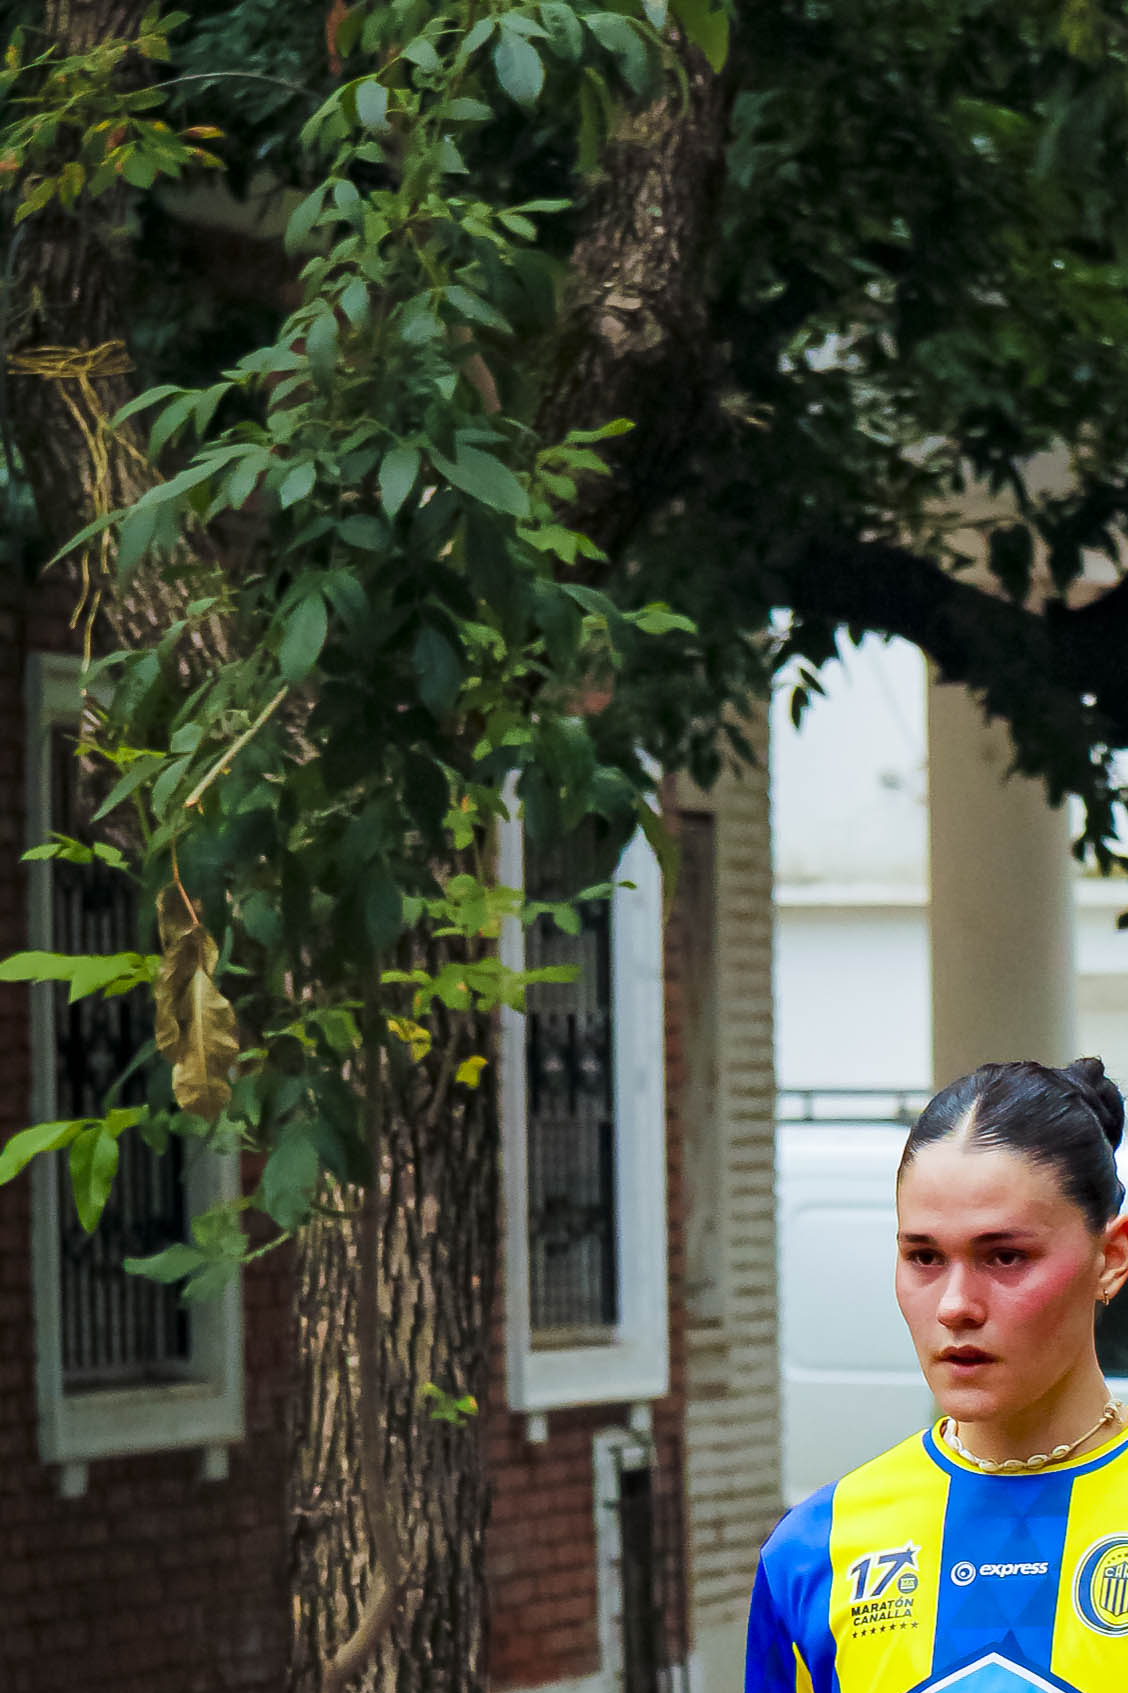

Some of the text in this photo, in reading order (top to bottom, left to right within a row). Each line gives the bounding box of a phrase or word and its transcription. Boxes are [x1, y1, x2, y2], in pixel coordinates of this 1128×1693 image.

[849, 1546, 918, 1601] 17
[979, 1561, 1049, 1578] express
[851, 1597, 914, 1616] MARATÓN
[853, 1608, 912, 1627] CANALLA
